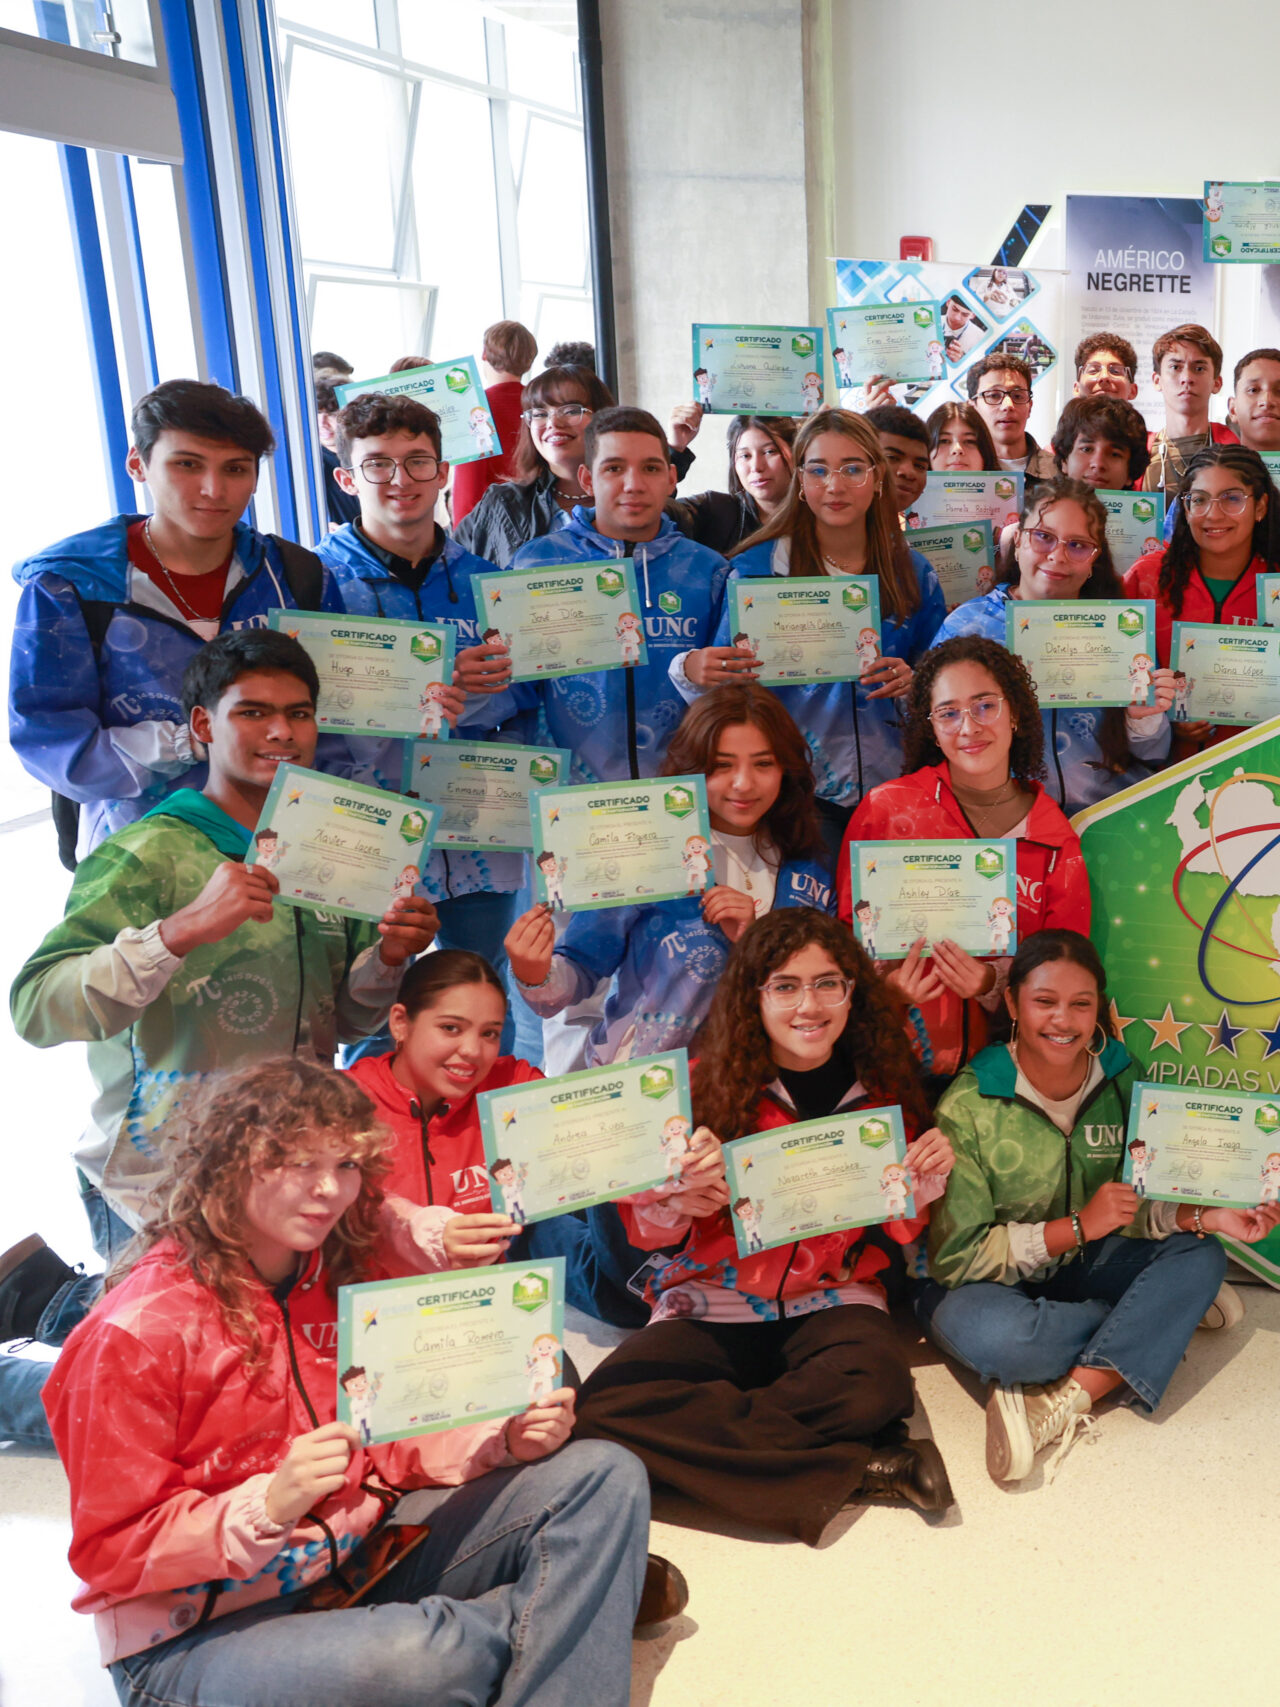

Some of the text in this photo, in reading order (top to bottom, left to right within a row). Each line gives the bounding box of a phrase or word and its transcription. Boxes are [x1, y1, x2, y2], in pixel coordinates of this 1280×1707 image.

[1094, 244, 1185, 272] AMÉRICO
[1087, 272, 1192, 294] NEGRETTE
[864, 313, 905, 322] CERTIFICADO
[735, 335, 782, 344] CERTIFICADO
[383, 378, 435, 397] CERTIFICADO
[527, 577, 585, 591] CERTIFICADO
[777, 590, 831, 600] CERTIFICADO
[530, 611, 552, 625] José
[1053, 613, 1107, 622] CERTIFICADO
[644, 616, 698, 638] UNC
[331, 629, 398, 643] CERTIFICADO
[1219, 637, 1269, 647] CERTIFICADO
[459, 754, 518, 765] CERTIFICADO
[333, 796, 392, 818] CERTIFICADO
[588, 795, 650, 808] CERTIFICADO
[902, 854, 962, 863] CERTIFICADO
[1016, 874, 1043, 903] NC
[550, 1080, 624, 1104] CERTIFICADO
[1185, 1102, 1243, 1114] CERTIFICADO
[781, 1130, 845, 1151] CERTIFICADO
[449, 1162, 490, 1194] UN
[416, 1285, 496, 1307] CERTIFICADO
[413, 1334, 457, 1354] Camila
